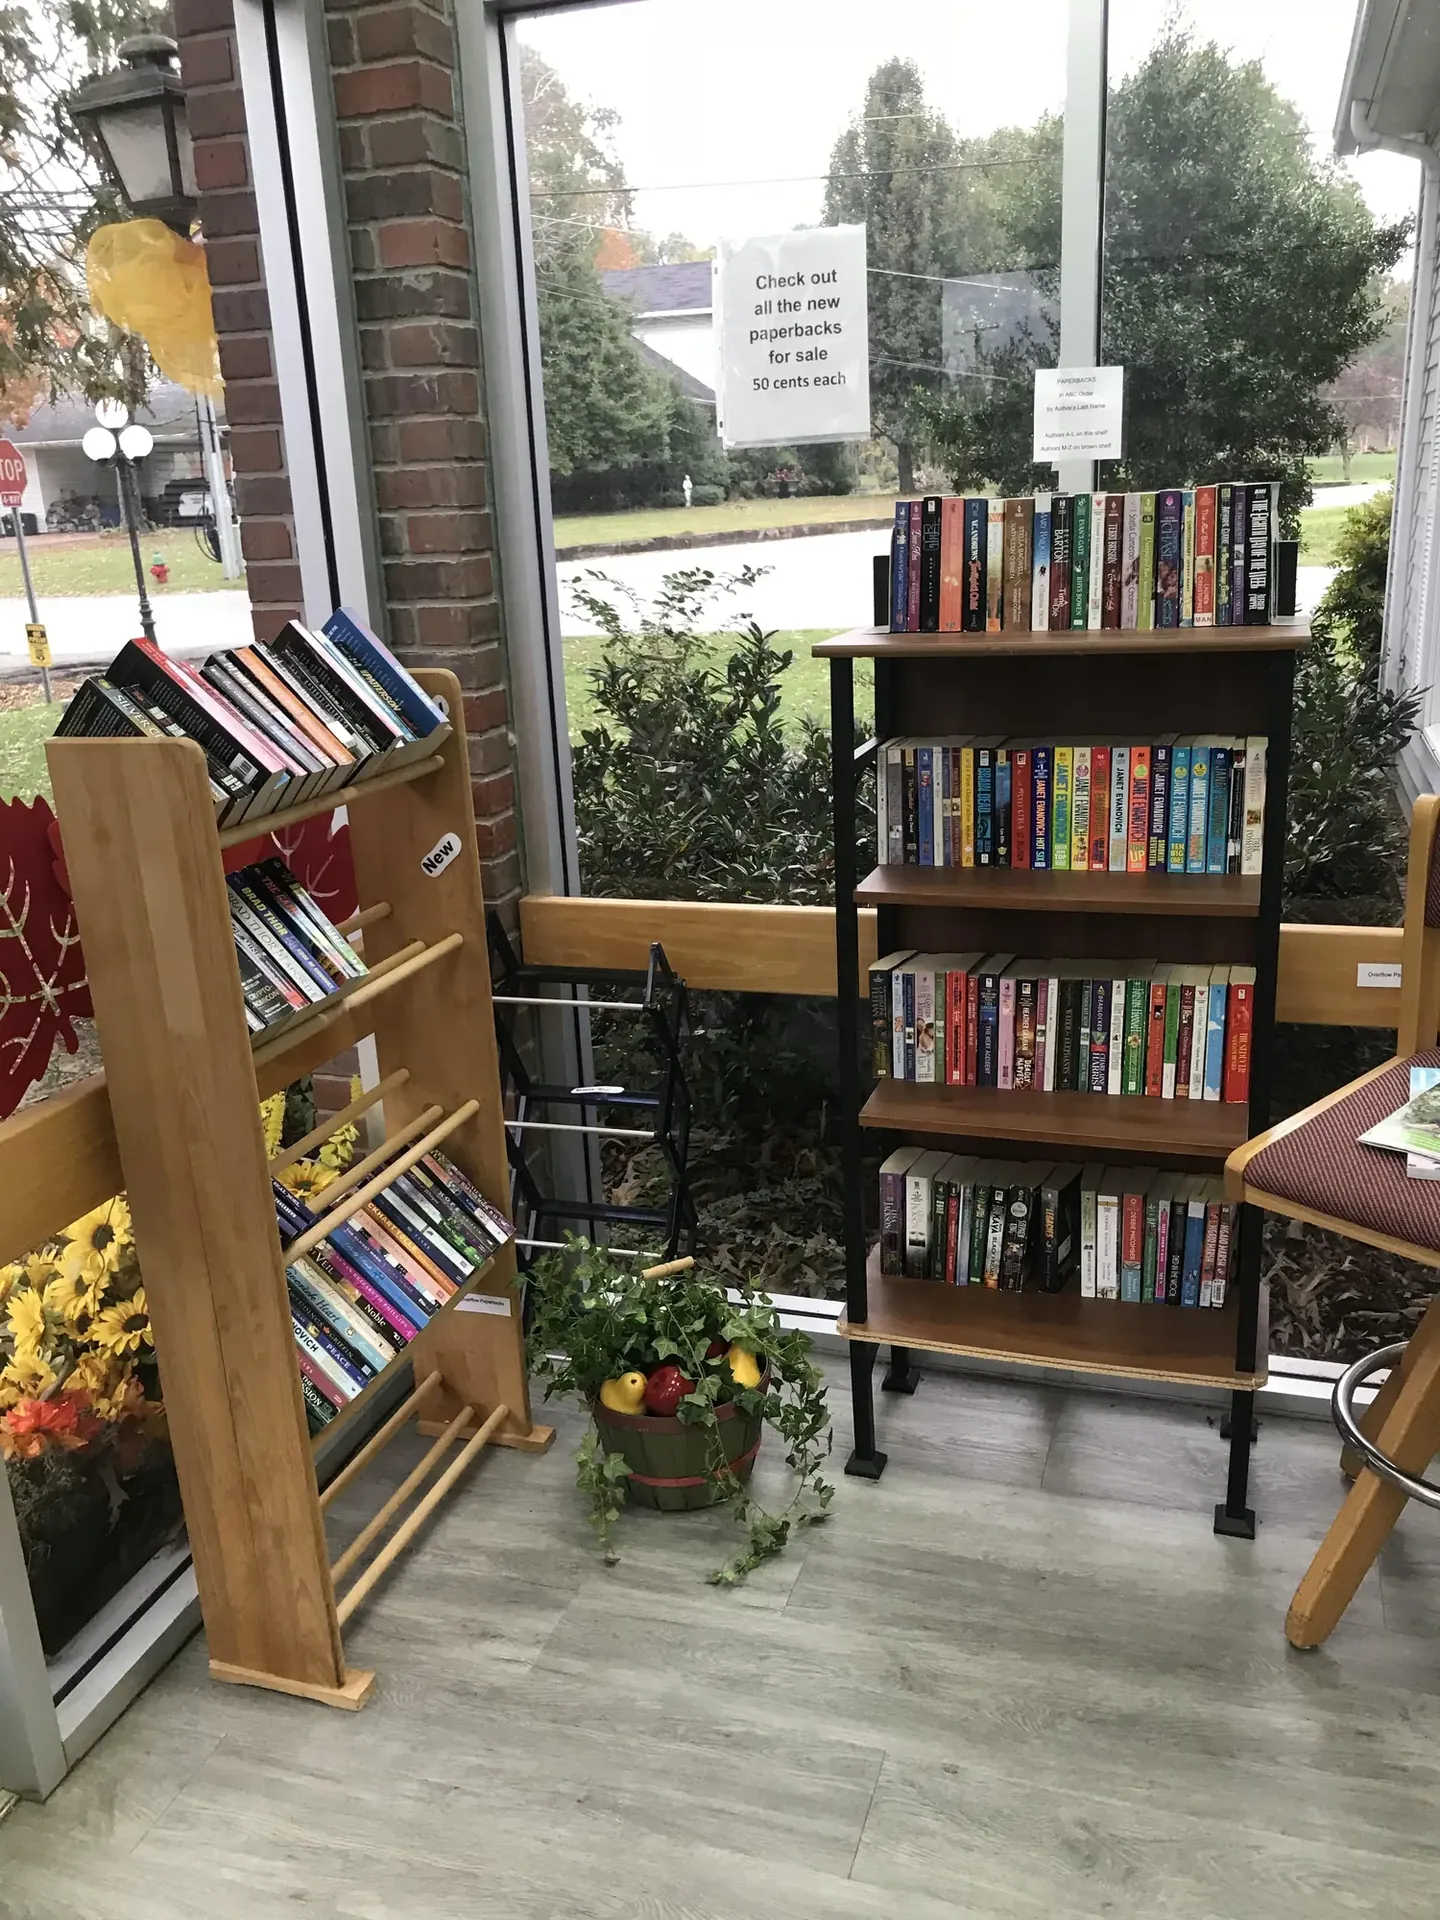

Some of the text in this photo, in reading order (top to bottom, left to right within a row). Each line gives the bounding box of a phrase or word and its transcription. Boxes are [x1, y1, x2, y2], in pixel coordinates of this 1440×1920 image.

[756, 269, 837, 290] Check out
[754, 297, 840, 315] all the new
[749, 320, 842, 345] paperbacks
[769, 346, 828, 364] for sale
[753, 371, 846, 391] 50 cents each
[1057, 376, 1096, 384] PAPERBACKS
[0, 458, 23, 481] TOP
[1201, 508, 1209, 521] The
[1251, 499, 1268, 512] THE
[1249, 512, 1269, 536] EIGHTH
[1054, 529, 1063, 563] BARTON
[1128, 532, 1136, 561] Cameron
[1160, 522, 1173, 560] CHASE
[1249, 536, 1268, 549] DAY
[1250, 549, 1267, 557] OF
[1250, 558, 1267, 571] THE
[1248, 571, 1267, 589] WEEK
[1052, 603, 1060, 617] Die
[1075, 593, 1083, 615] BOWEN
[113, 694, 150, 728] SILVER
[977, 767, 991, 813] BRAIN DEAD
[1036, 779, 1046, 799] JANET
[1193, 778, 1206, 799] JANET
[1213, 765, 1227, 791] JANET
[1055, 763, 1068, 844] JANET EVANOVICH
[1073, 776, 1089, 837] JANET EVANOVICH
[1115, 768, 1125, 833] JANET EVANOVICH
[1131, 777, 1147, 842] JANET EVANOVICH
[1152, 773, 1166, 833] JANET EVANOVICH
[1171, 778, 1187, 838] JANET EVANOVICH
[1036, 800, 1046, 836] EVANOVICH
[1191, 800, 1206, 835] EVANOVICH
[1036, 837, 1045, 850] HOT
[1036, 851, 1045, 862] SIX
[1129, 850, 1146, 862] UP
[1149, 836, 1157, 867] SEVENTEEN
[1157, 839, 1165, 864] SMOKIN'
[1245, 829, 1254, 862] POSSESSION
[422, 840, 454, 874] New
[241, 887, 289, 936] BRAD THOR
[249, 919, 277, 950] THOR
[1021, 1007, 1030, 1051] HEATHER GRAHAM
[1063, 1008, 1072, 1074] WATER ELEPHANTS
[1016, 1057, 1024, 1085] HARVEST
[1024, 1059, 1032, 1083] DEADLY
[1092, 1052, 1100, 1085] HARRIS
[439, 1191, 461, 1212] HOPE
[367, 1202, 415, 1252] CKHART TOLLE
[883, 1202, 894, 1229] JACKSON
[1045, 1208, 1054, 1238] LEGACIES
[1206, 1225, 1218, 1264] NGAIO MARSH
[1216, 1225, 1229, 1266] NGAIO MARSH
[315, 1249, 334, 1275] VEIL
[316, 1300, 341, 1323] Heart
[353, 1273, 385, 1304] ELIZABETH
[383, 1303, 408, 1328] PHILLIPS
[364, 1304, 386, 1327] Noble
[326, 1343, 351, 1369] PEACE
[329, 1332, 353, 1358] GRIFFIN
[302, 1375, 313, 1387] THE
